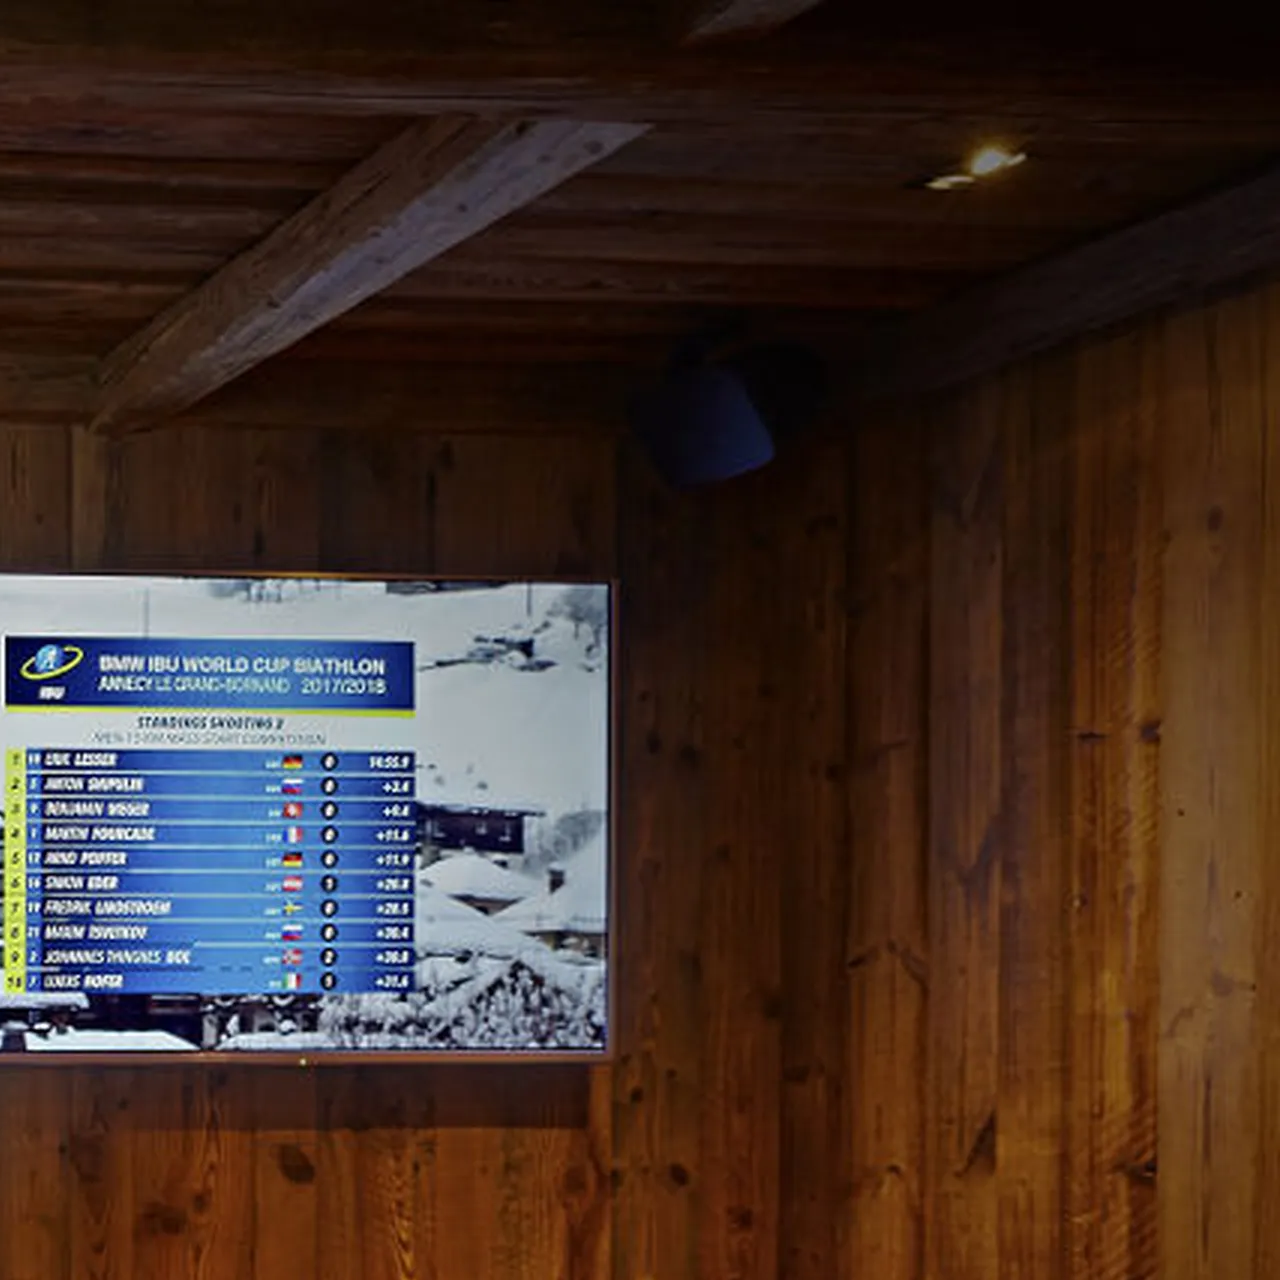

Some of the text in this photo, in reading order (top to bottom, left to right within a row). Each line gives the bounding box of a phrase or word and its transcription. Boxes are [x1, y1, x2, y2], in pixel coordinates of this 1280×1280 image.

[99, 655, 386, 675] BMW IBU WORLD CUP BIATHLON
[98, 676, 153, 692] ANNECY
[155, 677, 171, 692] LE
[302, 678, 387, 695] 2017/2018
[138, 716, 207, 730] STANDINGS
[210, 716, 273, 730] SHOOTING
[74, 753, 118, 767] LESSER
[11, 778, 20, 791] 2
[45, 802, 104, 816] BENJAMIN
[92, 828, 155, 841] FOURCADE
[11, 852, 20, 864] 5
[87, 876, 119, 889] EDER
[45, 900, 91, 915] FREDRIK
[11, 950, 20, 963] 9
[44, 950, 105, 964] JOHANNES
[83, 975, 124, 988] HOFER
